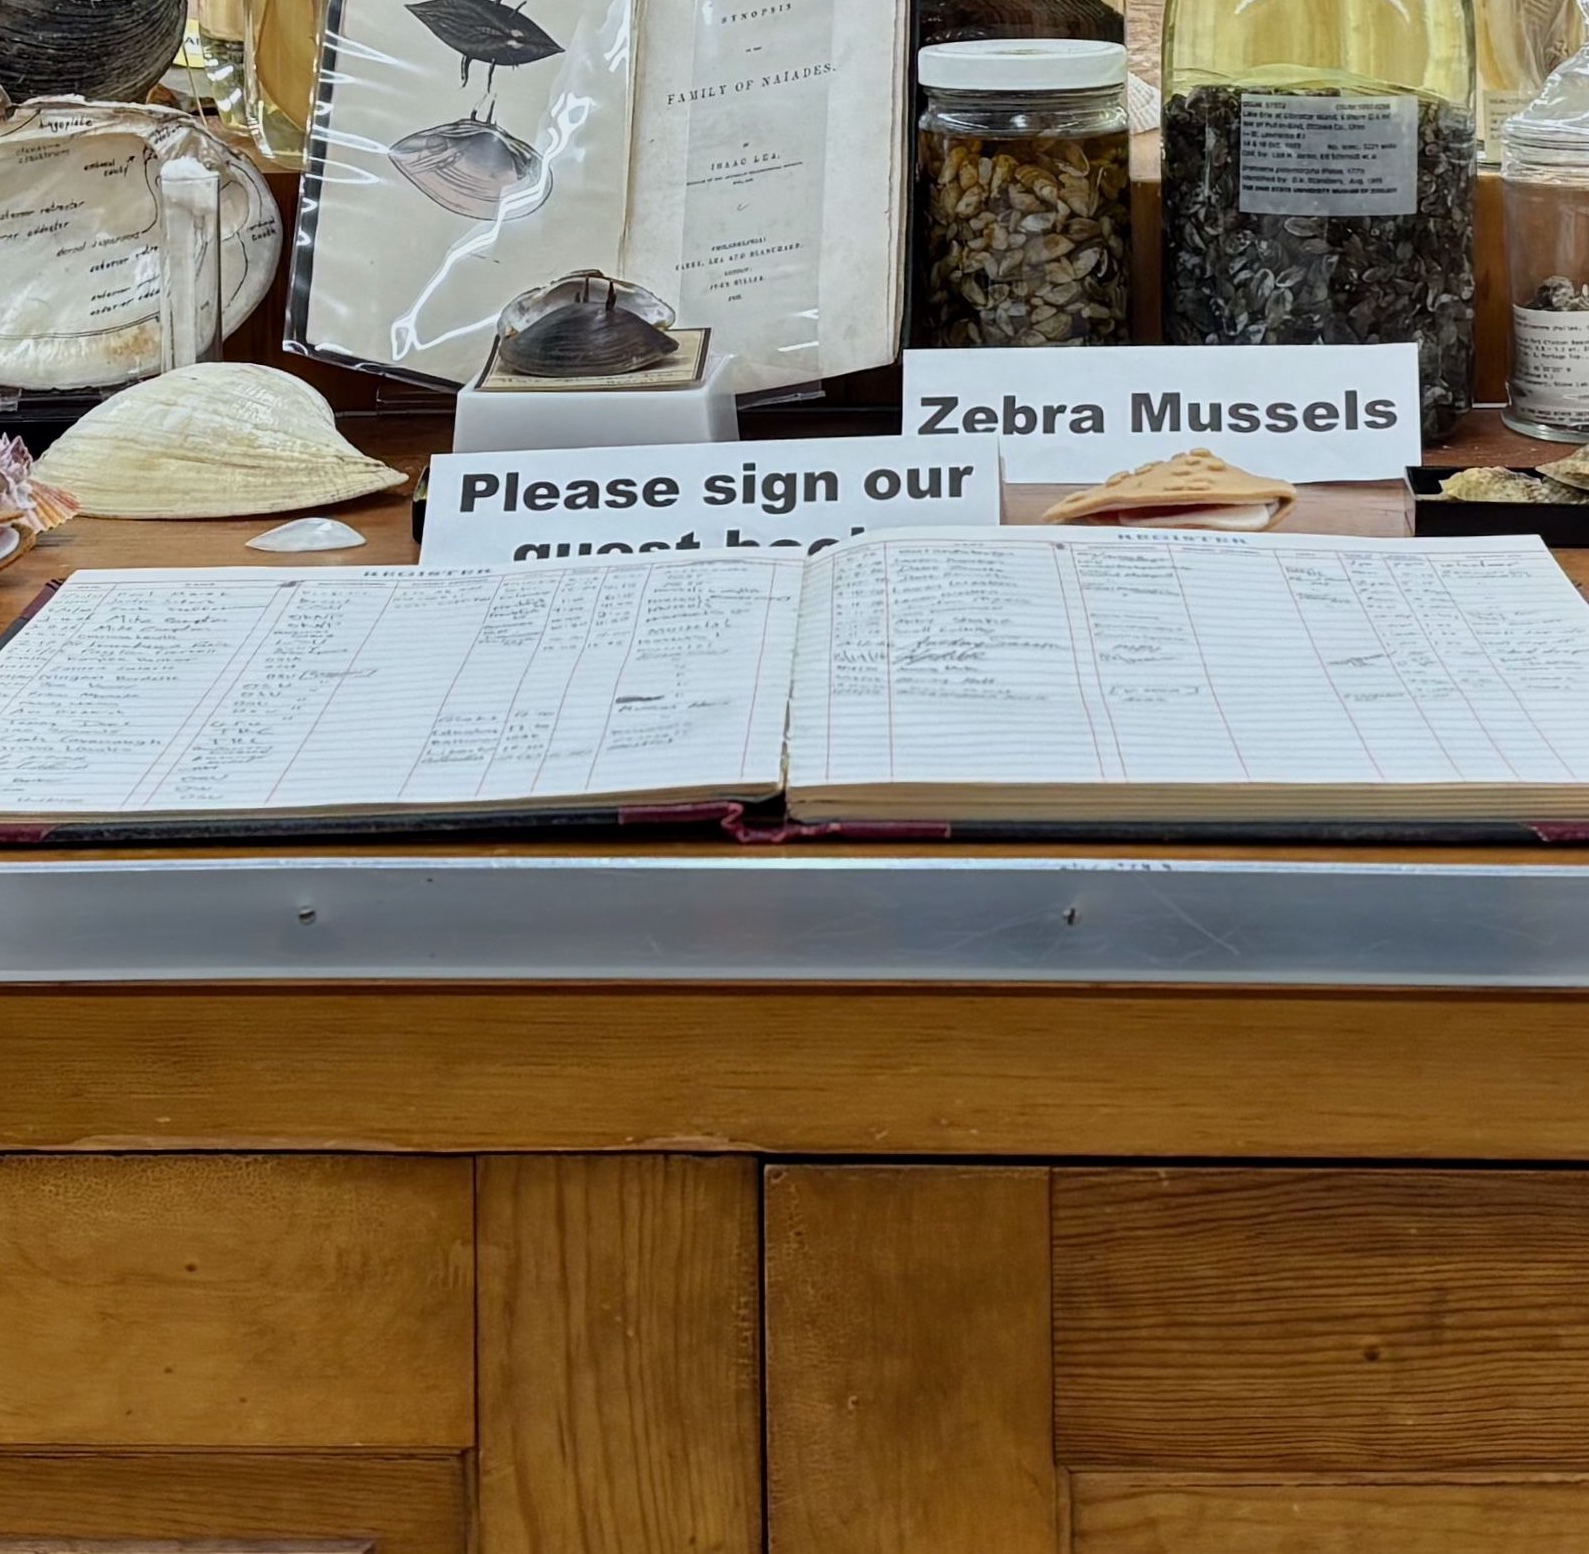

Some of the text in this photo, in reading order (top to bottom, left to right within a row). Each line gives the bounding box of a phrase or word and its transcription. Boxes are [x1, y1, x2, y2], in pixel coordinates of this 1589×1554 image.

[721, 2, 792, 24] SYNOPSIS
[666, 84, 727, 105] FAMILY
[734, 79, 754, 93] OF
[711, 157, 748, 171] ISAAC
[917, 390, 1398, 436] Zebra Mussels
[459, 462, 975, 515] Please sign our
